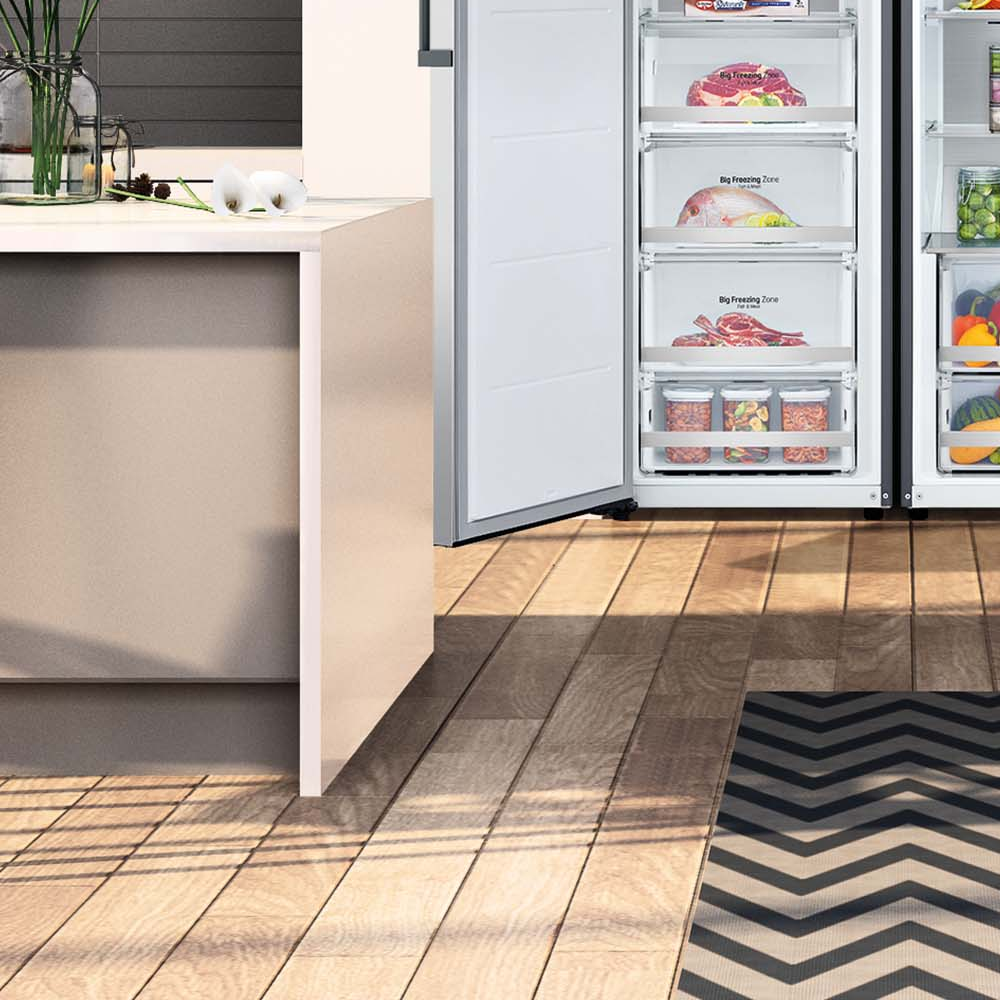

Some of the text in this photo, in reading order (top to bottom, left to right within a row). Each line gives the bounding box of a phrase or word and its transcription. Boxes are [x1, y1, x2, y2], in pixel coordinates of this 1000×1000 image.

[720, 71, 731, 80] Big
[732, 71, 762, 80] Freezing
[720, 176, 731, 184] Big
[732, 176, 761, 184] Freezing
[719, 295, 779, 304] Big Freezing Zone
